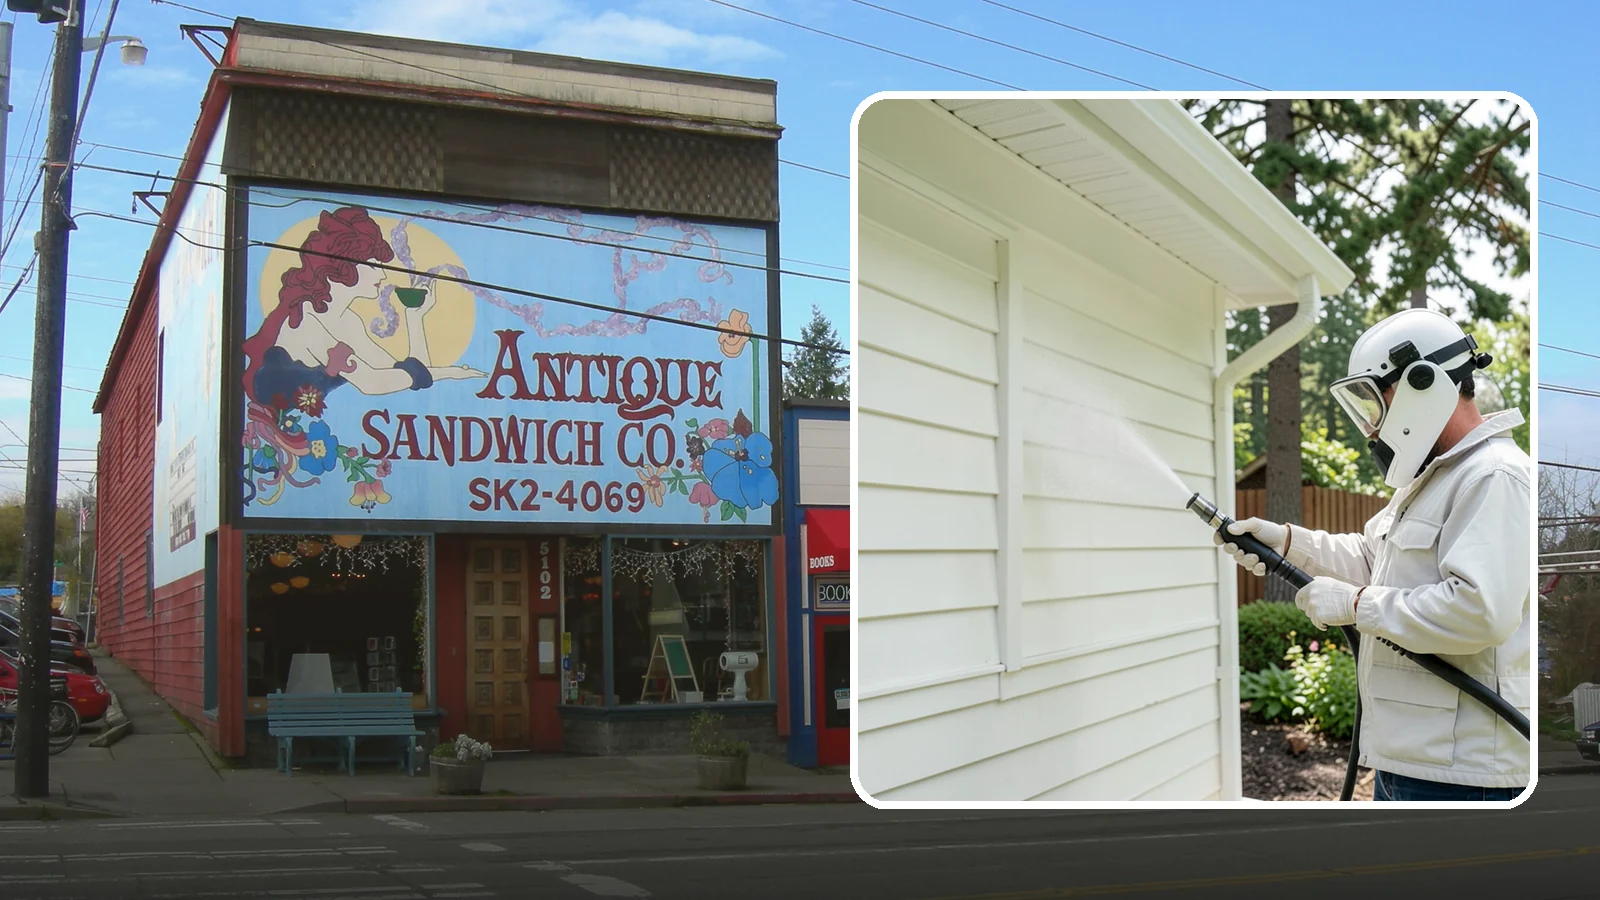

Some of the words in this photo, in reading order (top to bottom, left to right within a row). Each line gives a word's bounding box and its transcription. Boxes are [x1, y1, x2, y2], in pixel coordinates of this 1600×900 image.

[476, 329, 723, 420] ANTIQUE
[361, 408, 604, 467] SANDWICH
[617, 421, 685, 469] CO.
[468, 476, 645, 512] SK2-4069
[539, 541, 552, 599] 5102
[809, 555, 835, 569] BOOKS
